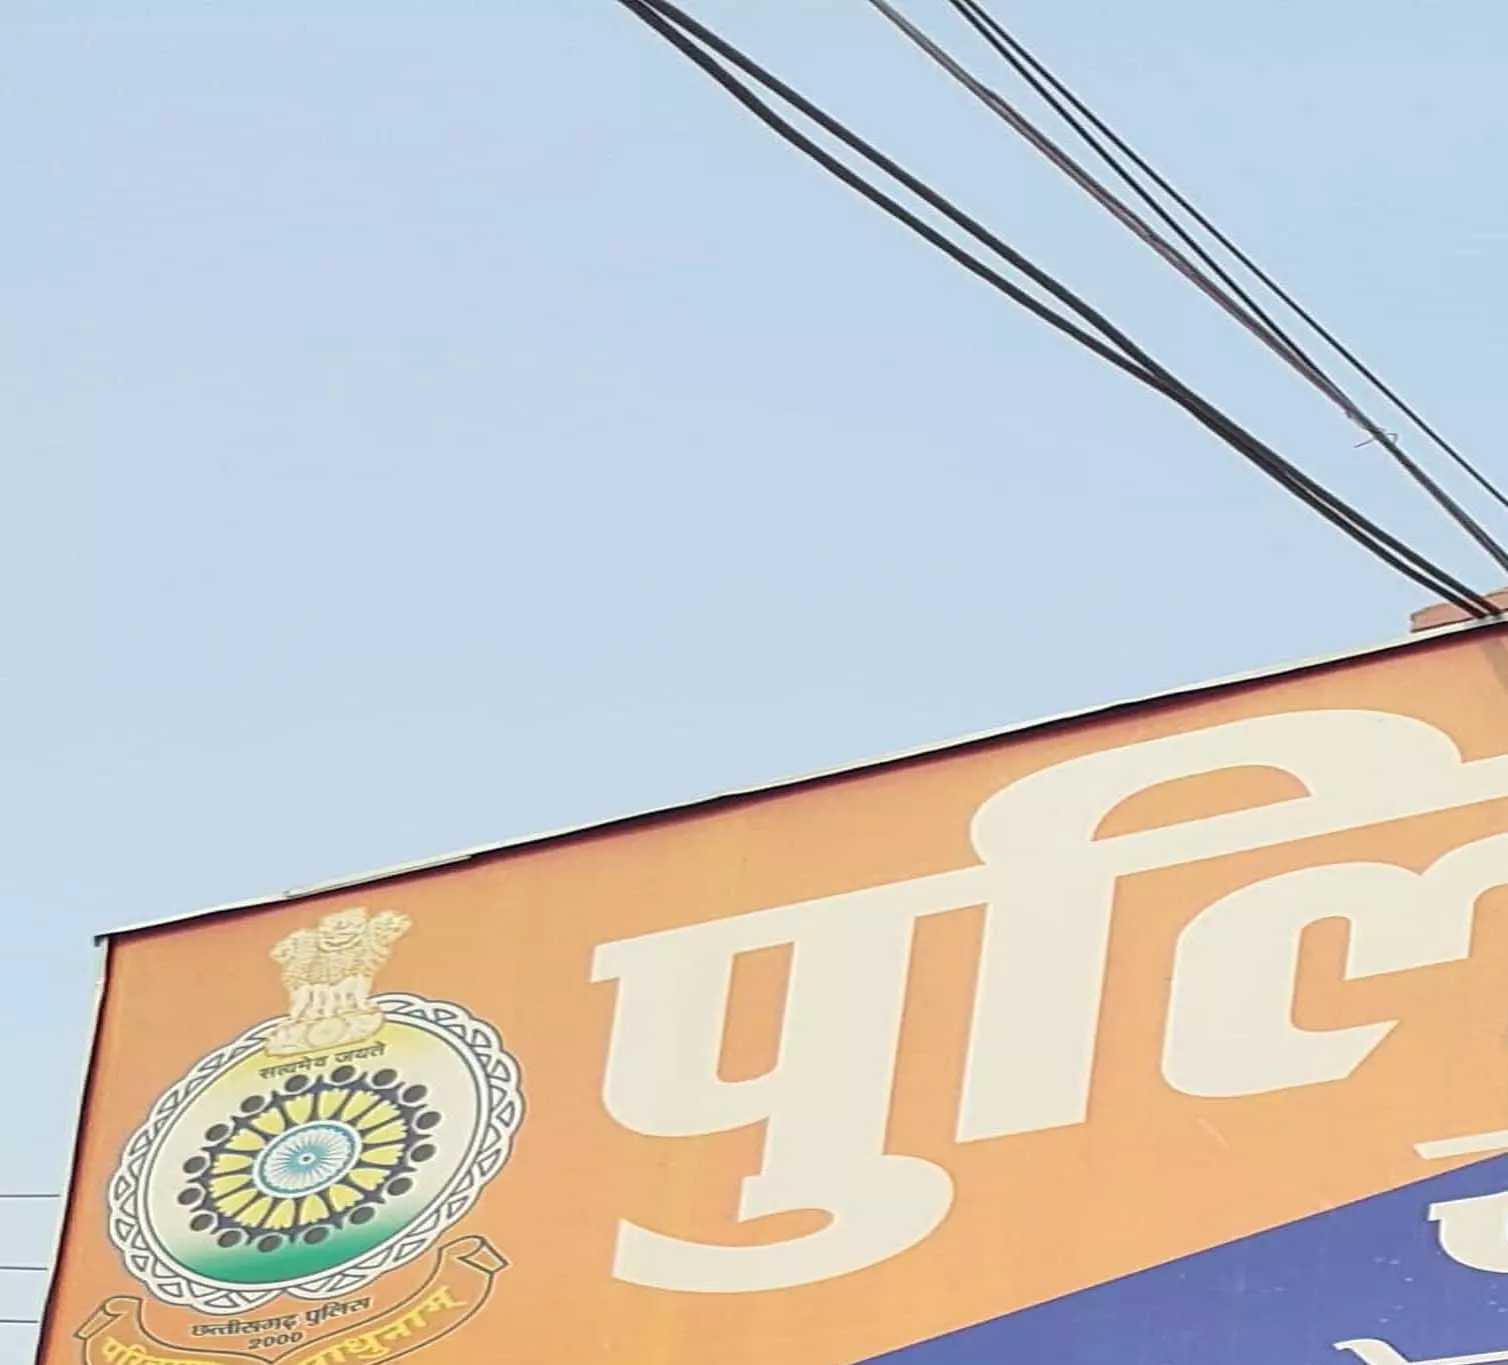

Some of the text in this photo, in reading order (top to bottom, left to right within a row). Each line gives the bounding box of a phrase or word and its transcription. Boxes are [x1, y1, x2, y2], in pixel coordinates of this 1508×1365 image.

[334, 1041, 387, 1065] जयते
[304, 1296, 370, 1326] पुलिस
[247, 1330, 304, 1350] 2000
